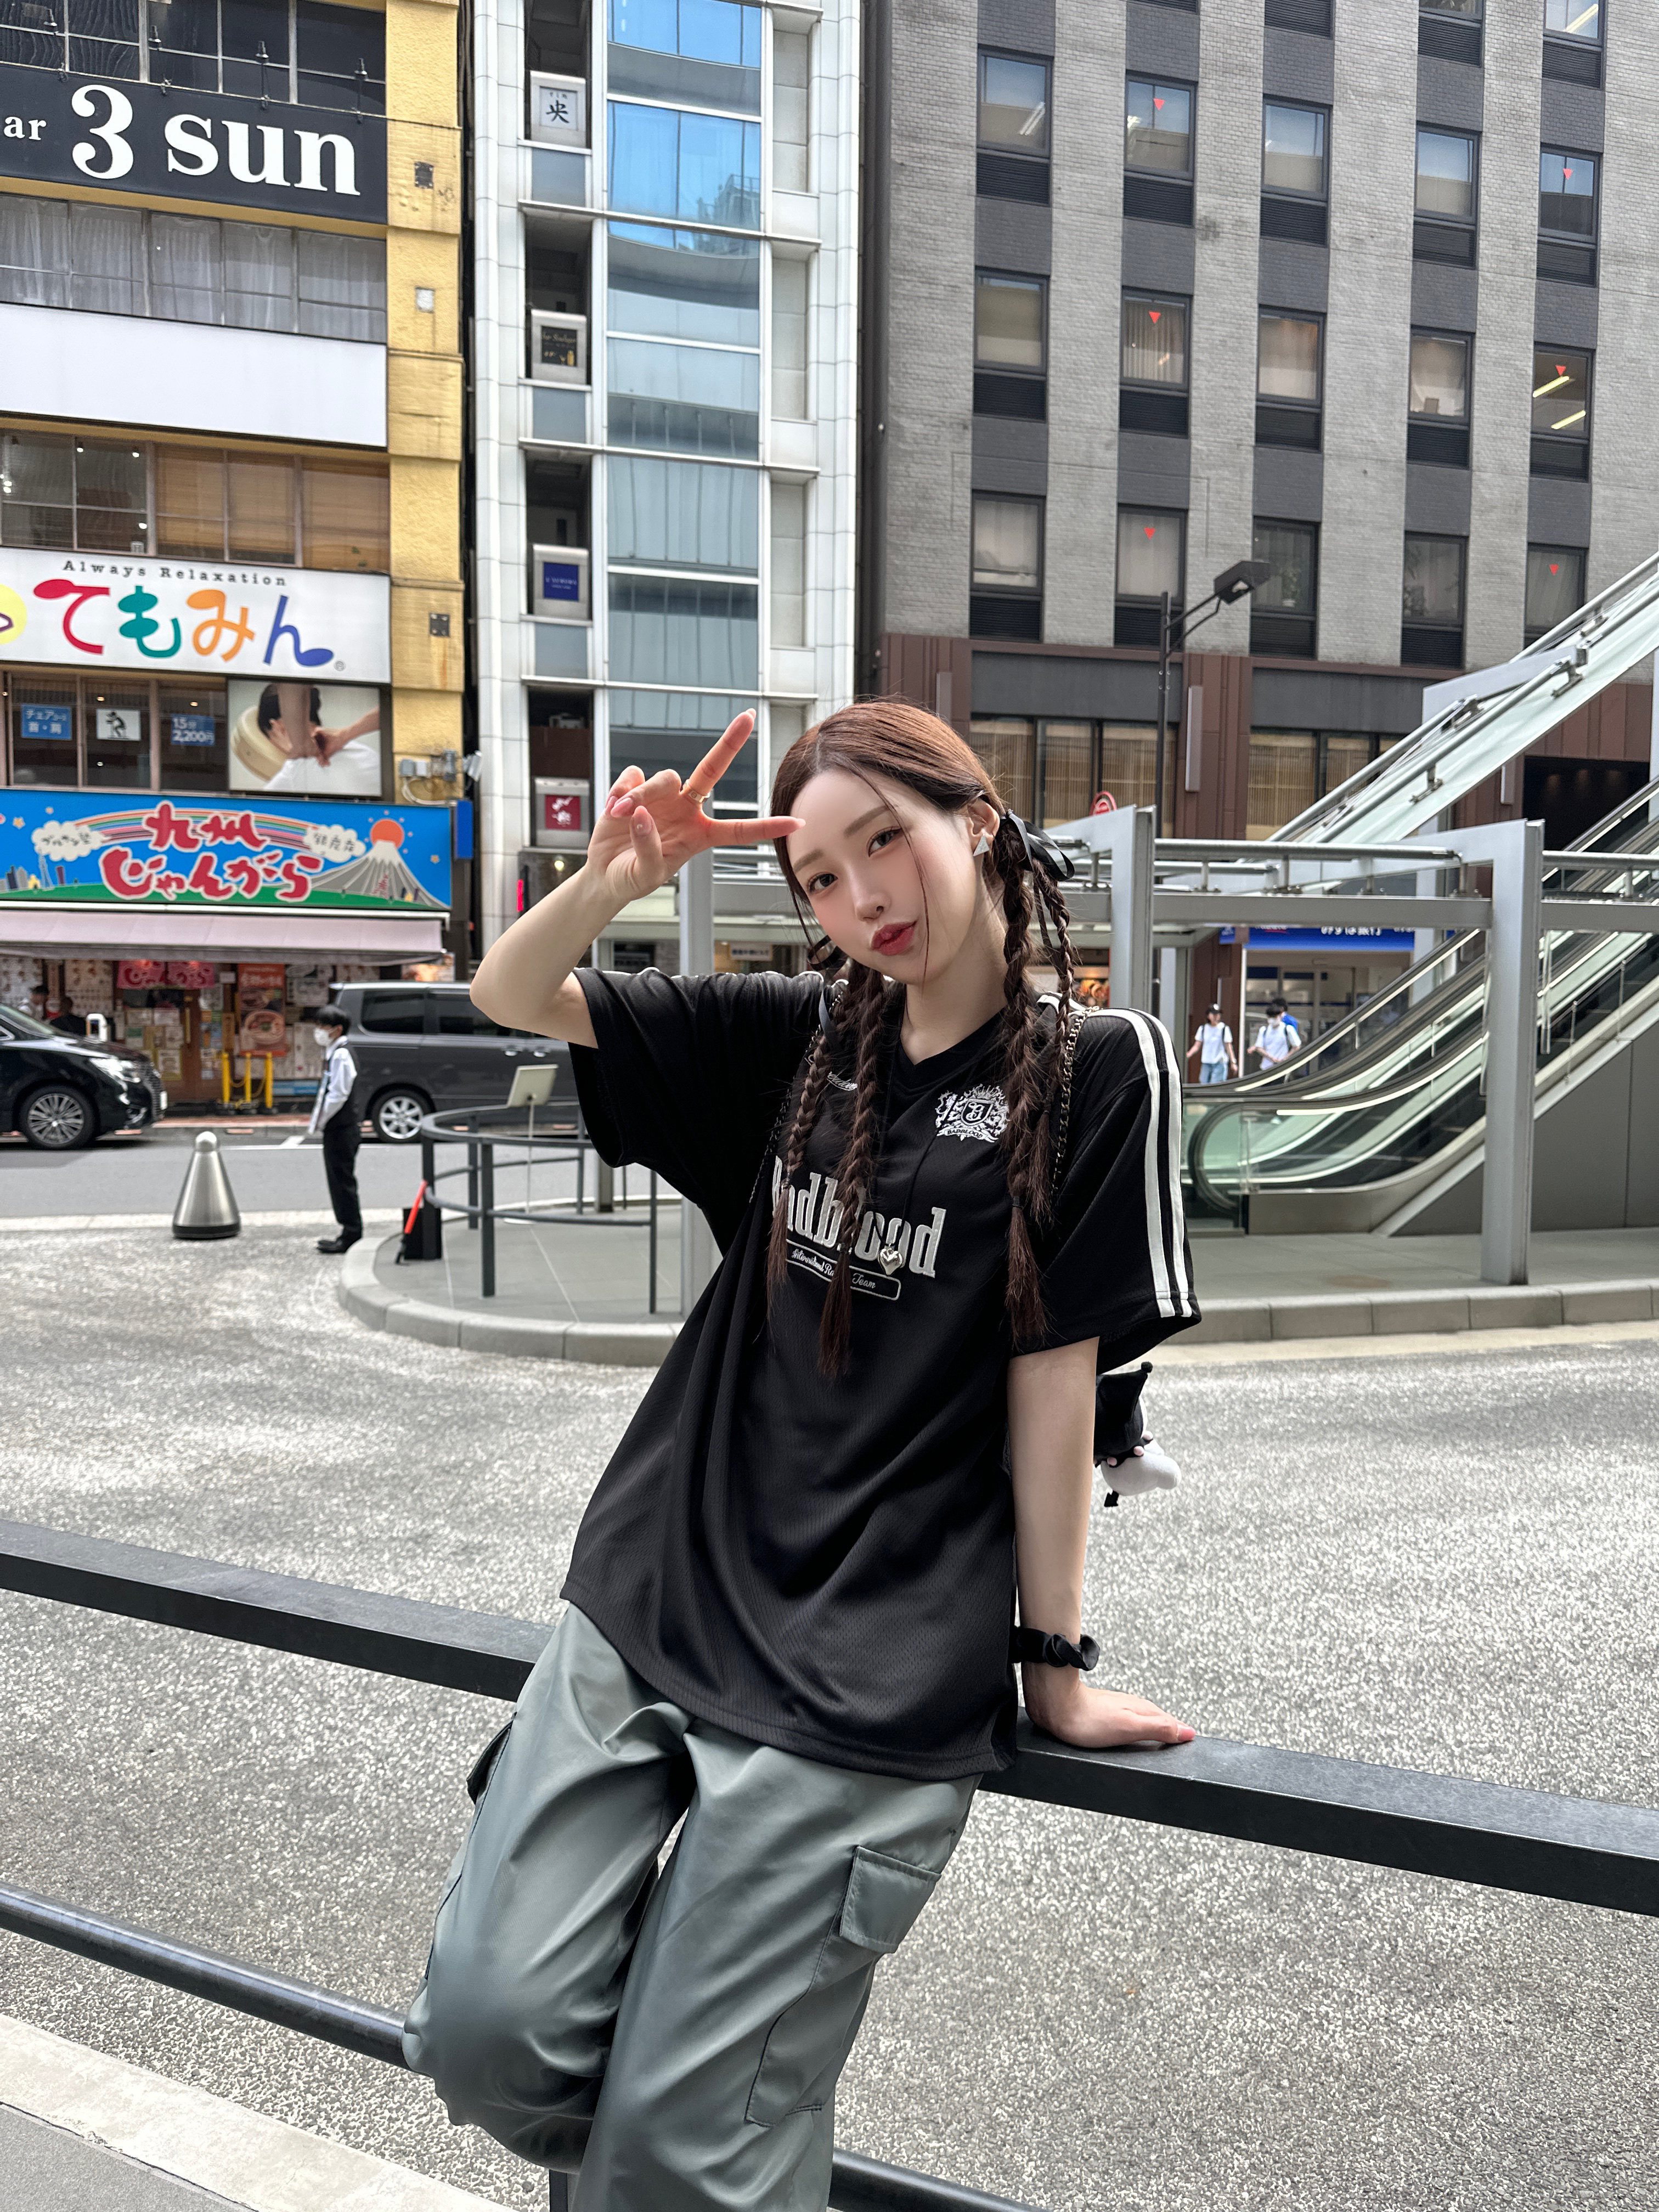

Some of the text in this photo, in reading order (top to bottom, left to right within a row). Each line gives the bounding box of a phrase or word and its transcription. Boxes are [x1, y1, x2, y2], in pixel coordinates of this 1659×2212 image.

[4, 84, 360, 195] ar 3 sun
[63, 560, 286, 586] Always Relaxation
[33, 579, 335, 667] てもみん
[143, 801, 269, 851] 九州
[100, 851, 323, 900] じゃんがら
[772, 1155, 947, 1279] Bdbood
[852, 1273, 876, 1289] Team
